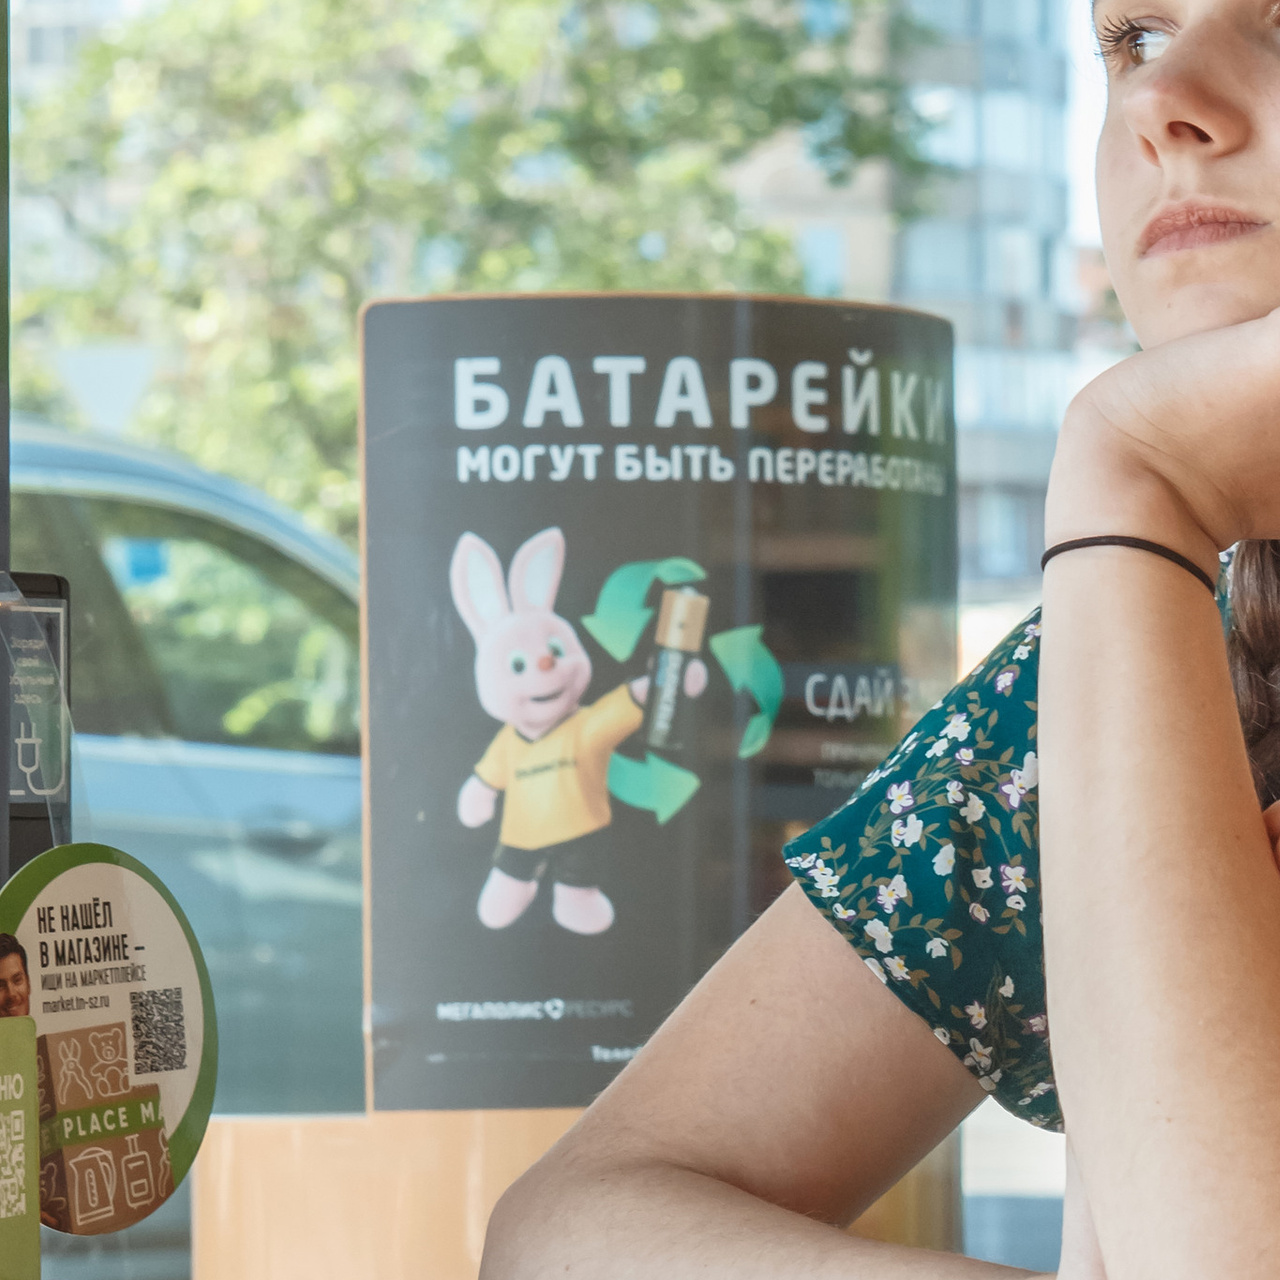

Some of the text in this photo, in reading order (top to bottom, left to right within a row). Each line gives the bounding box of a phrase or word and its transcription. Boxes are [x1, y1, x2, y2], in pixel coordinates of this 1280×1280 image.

[454, 347, 947, 446] БАТАРЕЙКИ
[456, 444, 603, 484] МОГУТ
[614, 443, 736, 482] БЫТЬ
[804, 666, 895, 723] СДАЙ
[37, 897, 113, 934] НЕ НАШЁЛ
[40, 940, 50, 968] В
[54, 933, 130, 967] МАГАЗИНЕ
[40, 963, 147, 991] ИЩИ НА МАРКЕТПЛЕЙСЕ
[62, 1106, 129, 1139] PLACE
